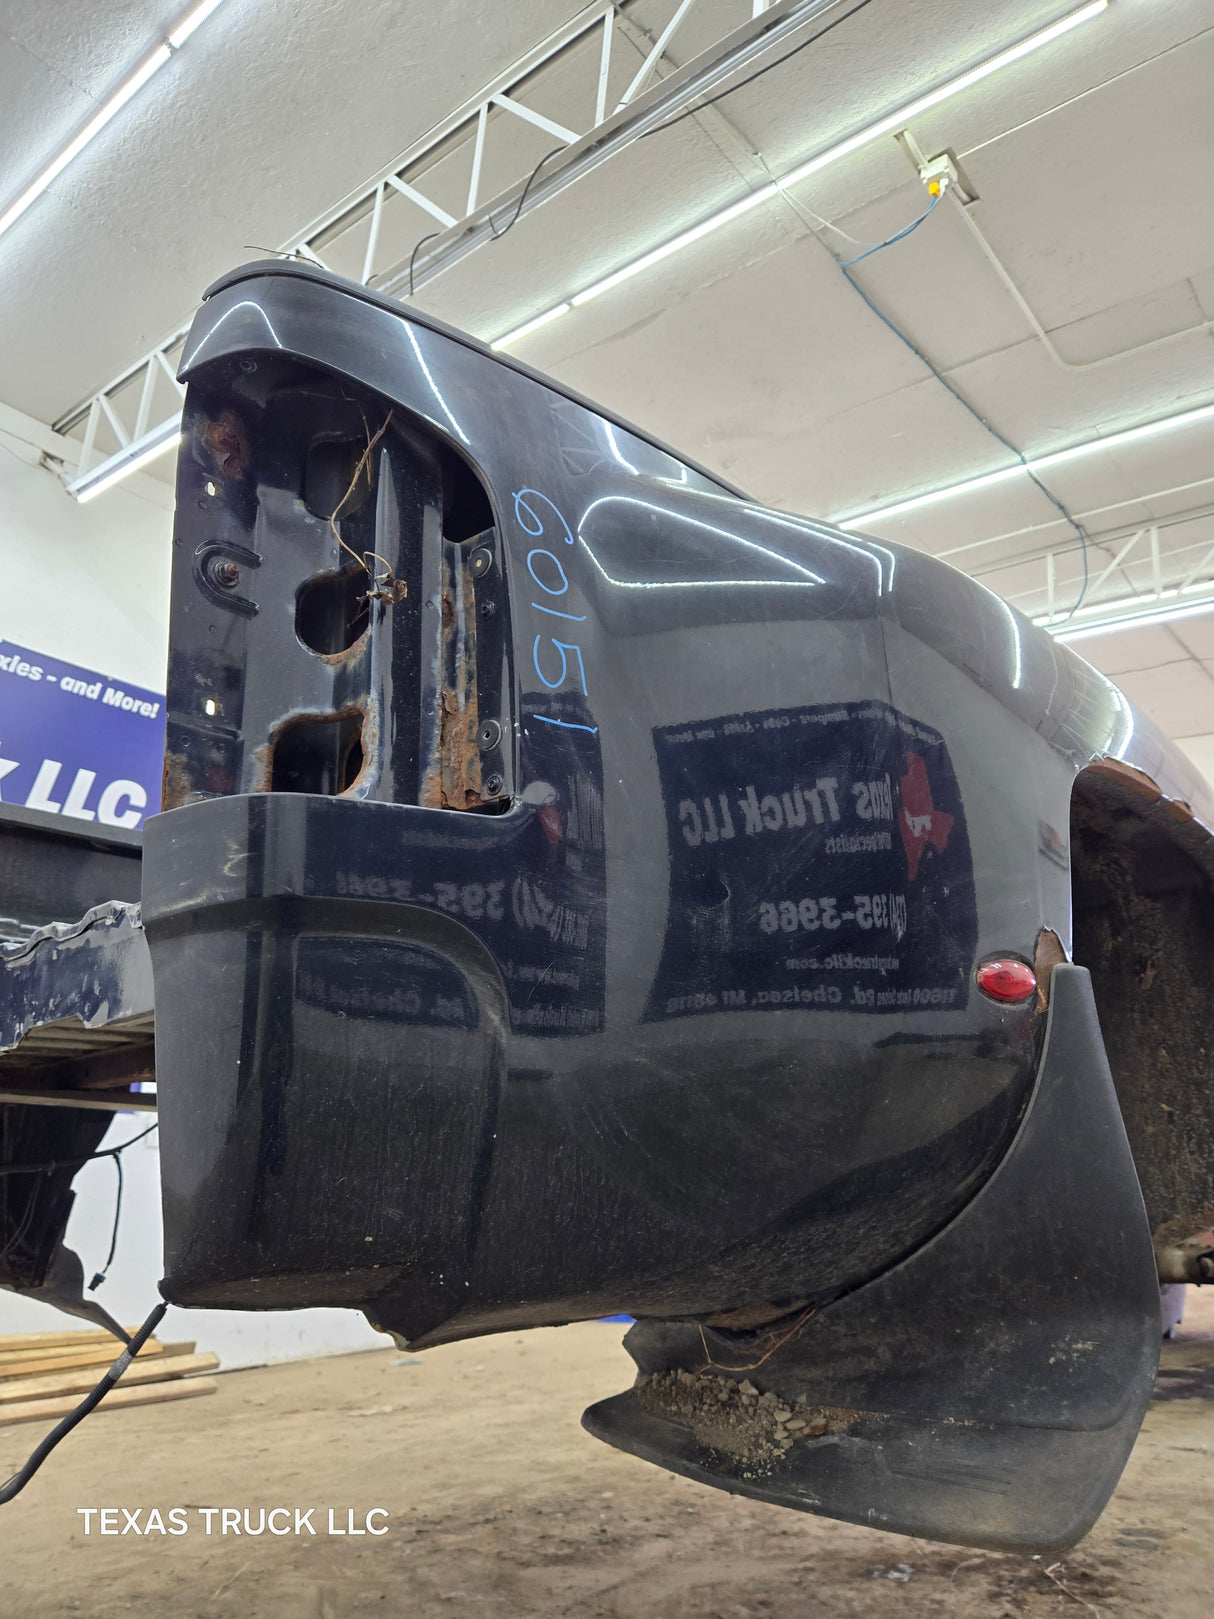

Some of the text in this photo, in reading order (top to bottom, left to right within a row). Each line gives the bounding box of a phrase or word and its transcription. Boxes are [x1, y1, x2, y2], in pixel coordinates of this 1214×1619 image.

[512, 488, 598, 734] 60151
[60, 676, 102, 700] and
[102, 687, 160, 719] More!
[25, 759, 148, 830] LLC
